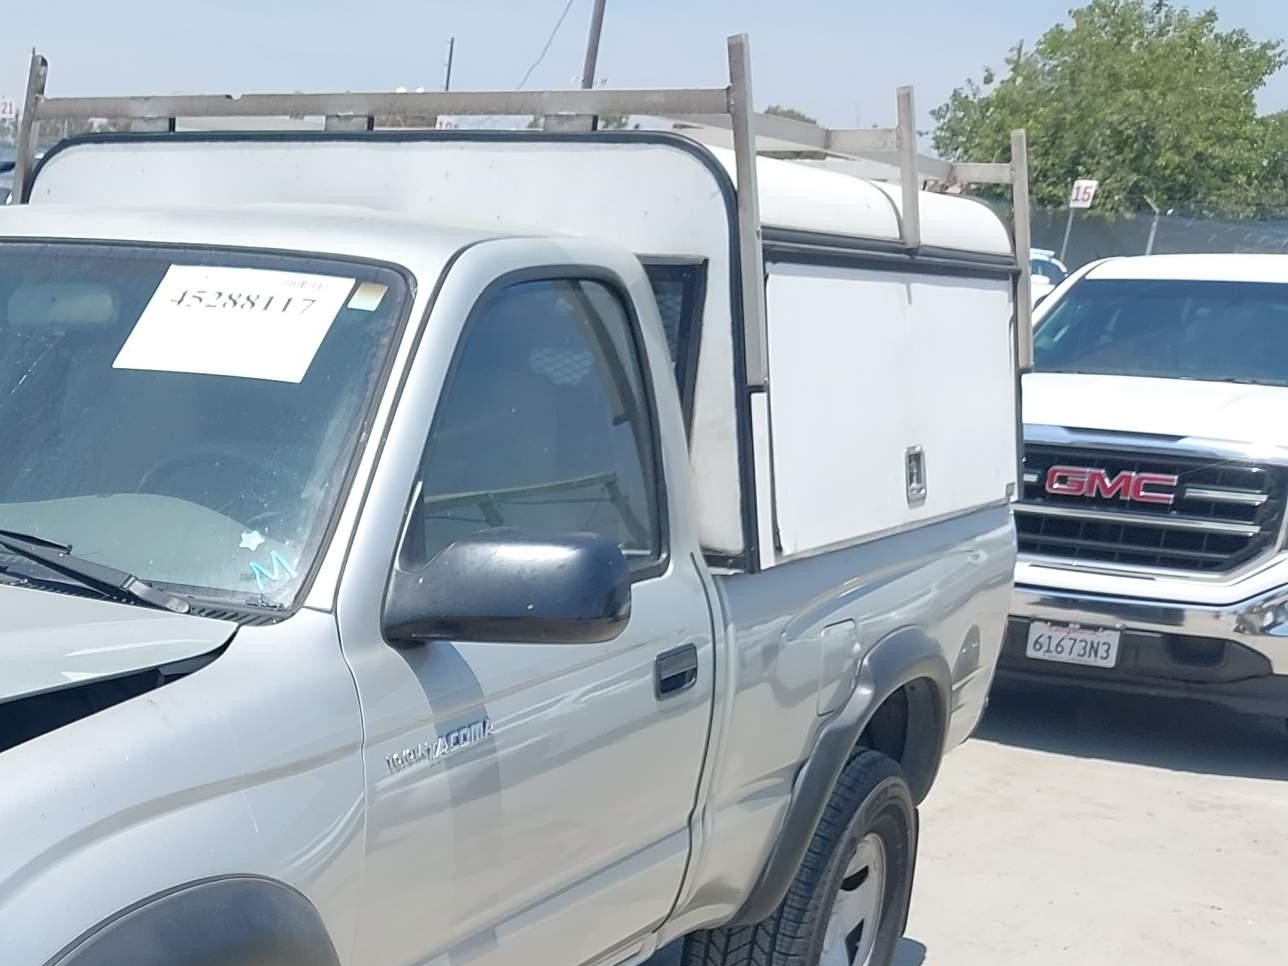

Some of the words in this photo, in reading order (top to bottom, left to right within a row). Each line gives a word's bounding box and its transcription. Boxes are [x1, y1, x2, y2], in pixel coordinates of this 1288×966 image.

[1, 102, 14, 115] 21
[1073, 186, 1094, 202] 15
[169, 290, 316, 315] 45288117
[1045, 465, 1179, 505] GMC
[1032, 633, 1111, 660] 61673N3
